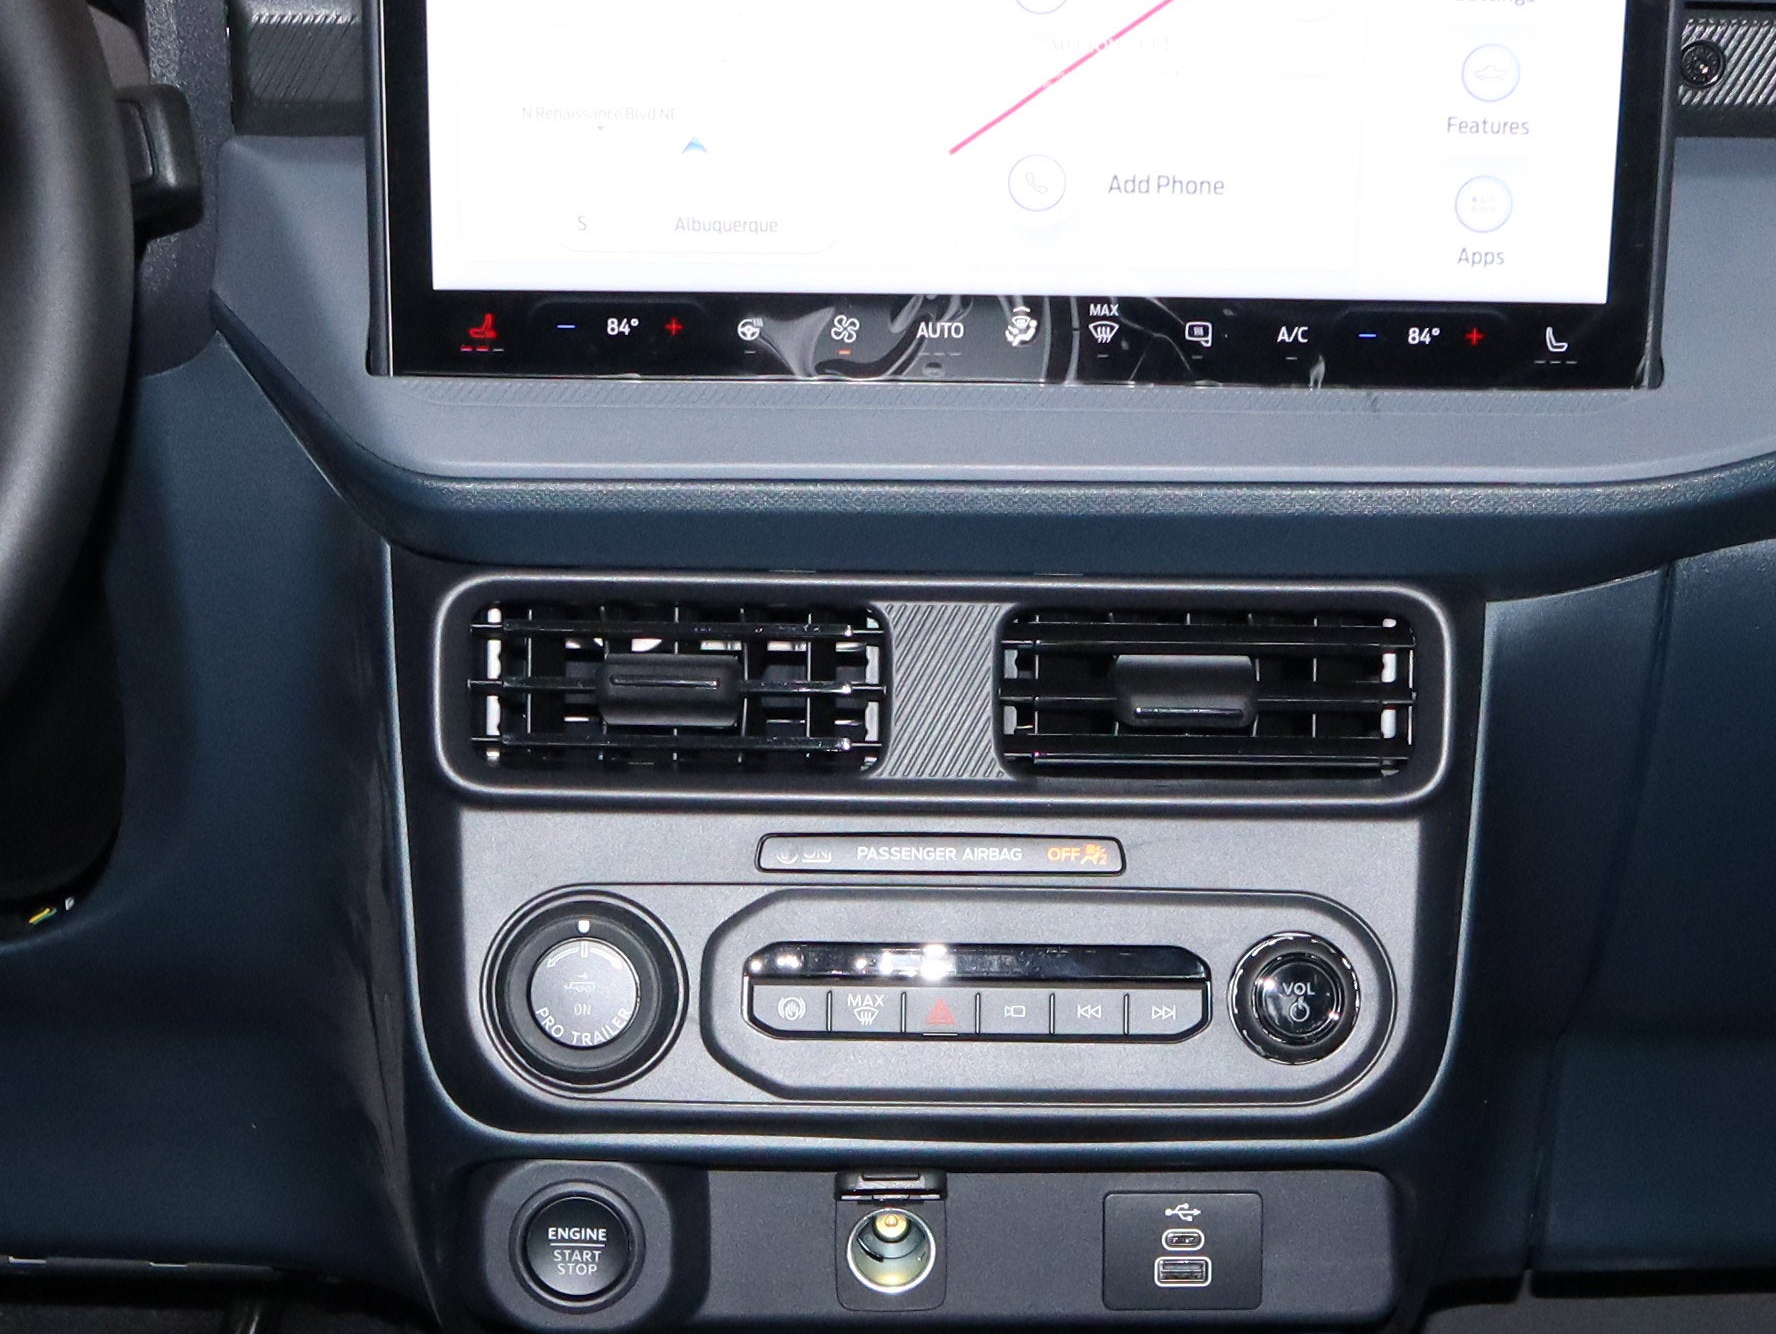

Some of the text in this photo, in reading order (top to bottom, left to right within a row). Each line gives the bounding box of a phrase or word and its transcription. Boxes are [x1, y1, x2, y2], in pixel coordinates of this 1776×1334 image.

[625, 106, 656, 121] Blvd
[1446, 116, 1530, 138] Features
[1107, 173, 1226, 197] Add Phone
[674, 215, 779, 237] Albuquerque
[1456, 247, 1506, 269] Apps
[1089, 303, 1120, 317] MAX
[607, 318, 640, 337] 84°
[916, 321, 964, 339] AUTO
[1277, 325, 1309, 345] A/C
[1407, 325, 1441, 345] 84°
[856, 847, 957, 861] PASSENGER
[962, 847, 1023, 862] AIRBAG
[1047, 847, 1081, 862] OFF
[1282, 982, 1316, 996] VOL
[847, 994, 885, 1008] MAX
[536, 1007, 632, 1046] PRO TRAILER
[547, 1227, 608, 1242] ENGINE
[553, 1249, 602, 1263] START
[557, 1263, 598, 1276] STOP
